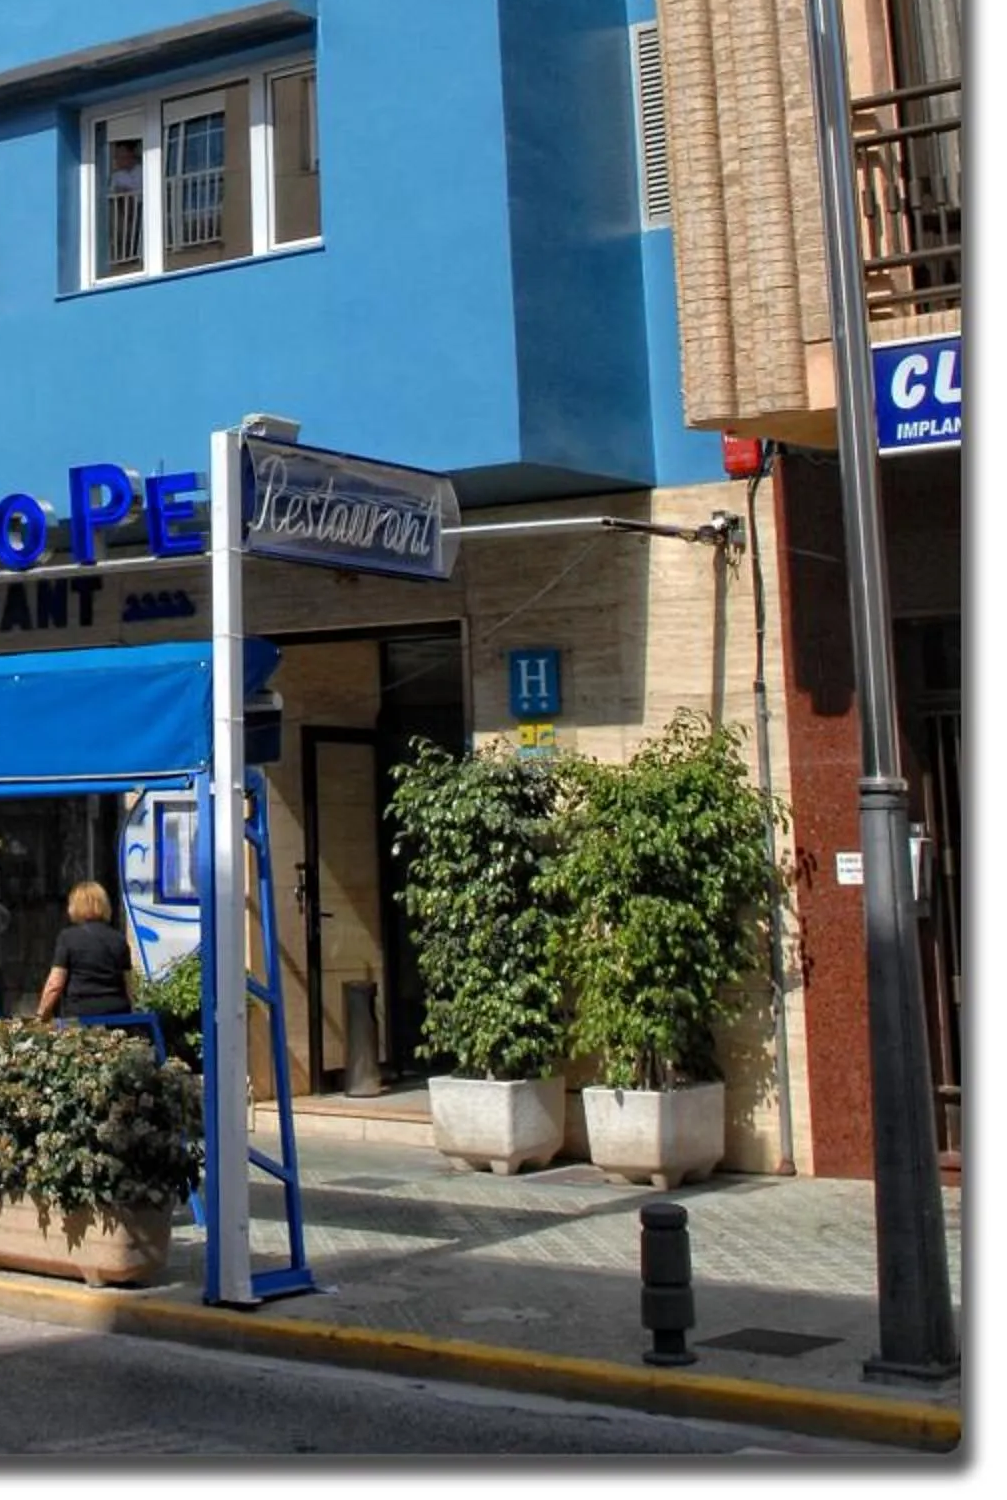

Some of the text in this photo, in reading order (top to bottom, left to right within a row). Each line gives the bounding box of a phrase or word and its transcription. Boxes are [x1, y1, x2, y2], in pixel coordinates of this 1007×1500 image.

[891, 350, 961, 409] CL
[247, 454, 436, 556] Restaurant
[517, 659, 549, 698] H
